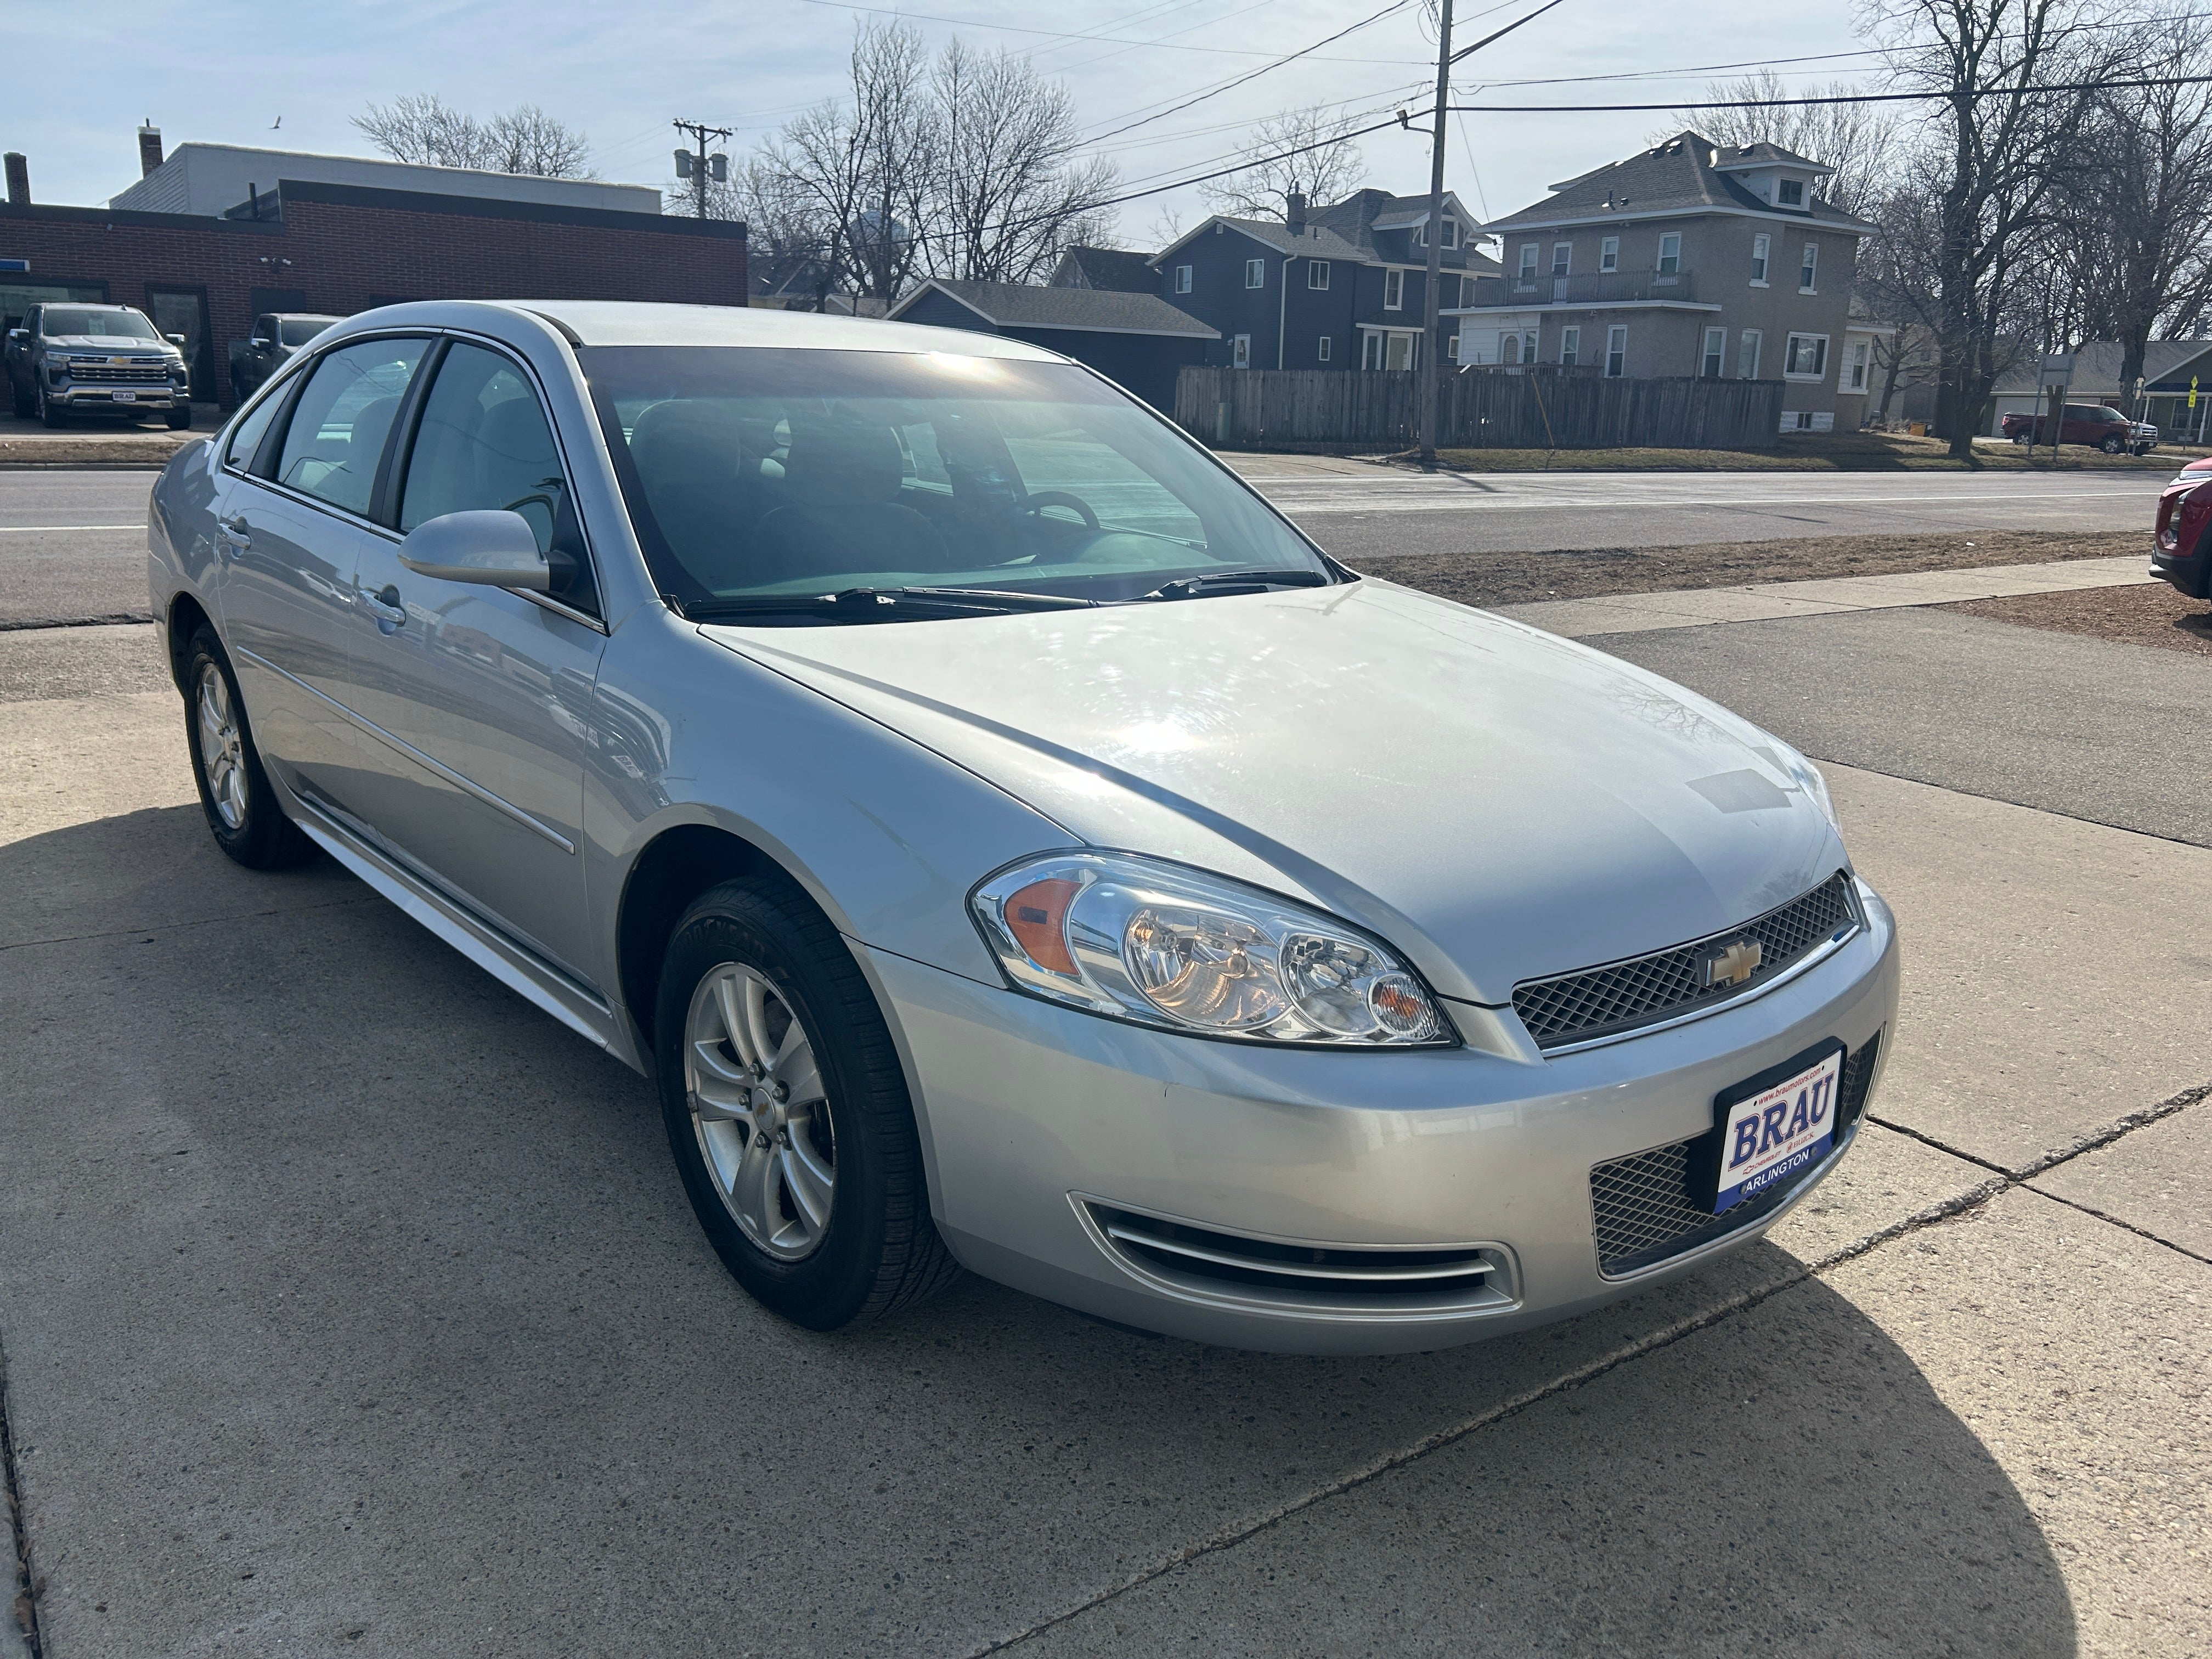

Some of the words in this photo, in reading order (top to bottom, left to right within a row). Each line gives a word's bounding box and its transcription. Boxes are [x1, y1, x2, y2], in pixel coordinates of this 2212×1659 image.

[1758, 1067, 1821, 1105] www.braumotors.com
[1728, 1070, 1835, 1172] BRAU
[1793, 1132, 1814, 1148] BUICK
[1745, 1149, 1809, 1193] ARLINGTON
